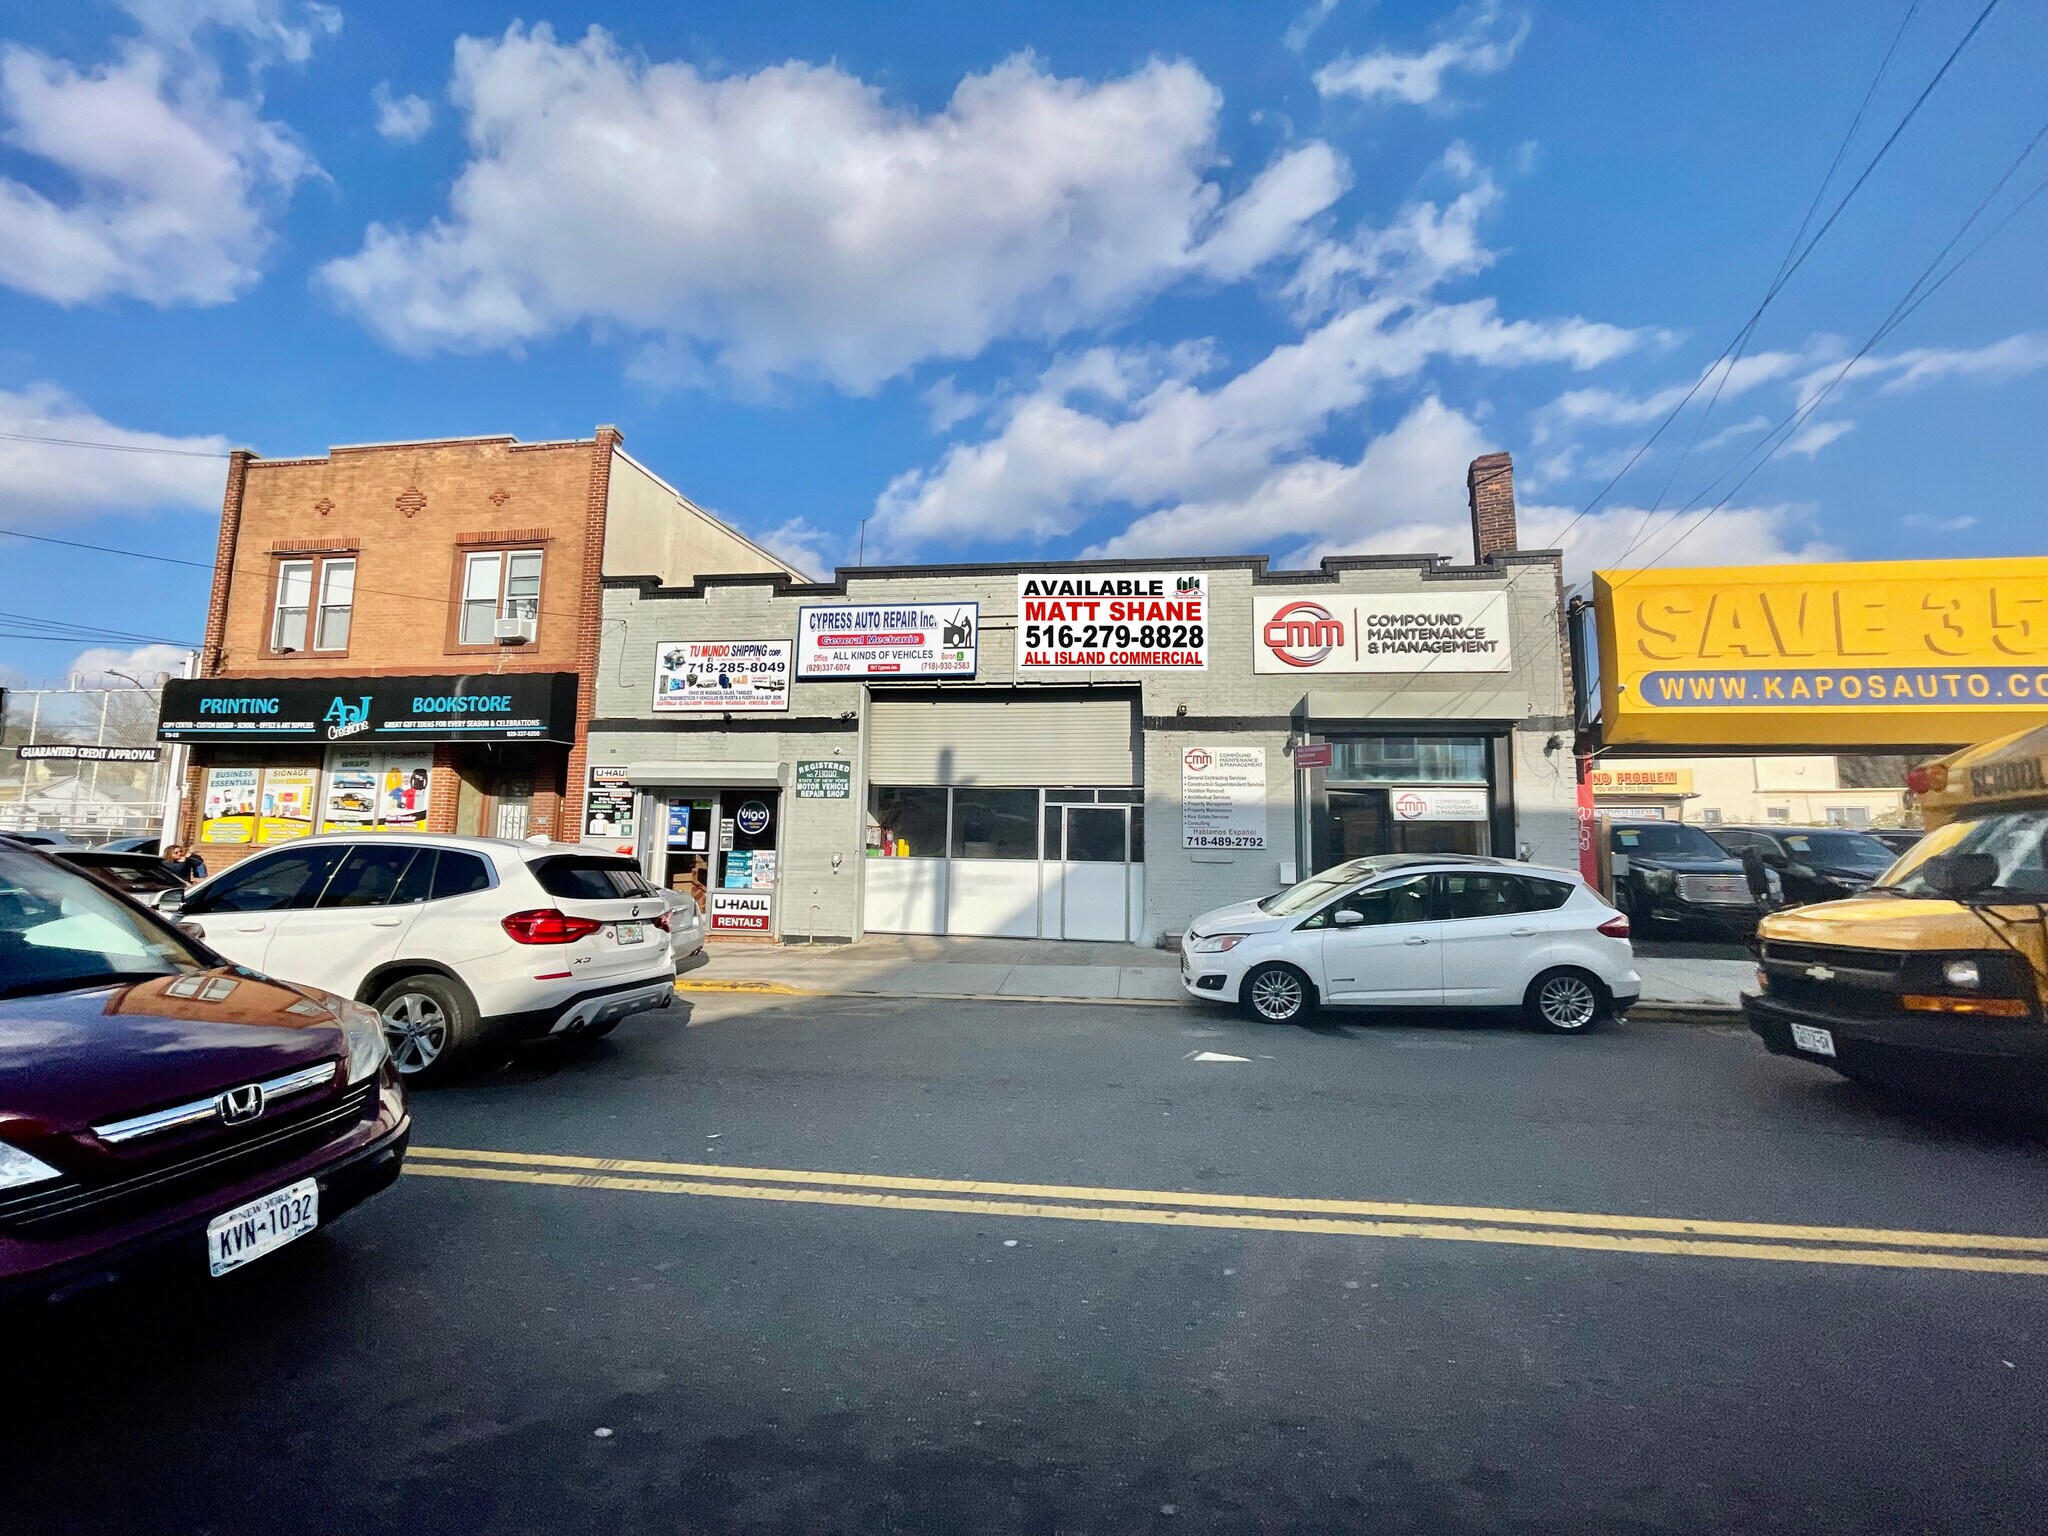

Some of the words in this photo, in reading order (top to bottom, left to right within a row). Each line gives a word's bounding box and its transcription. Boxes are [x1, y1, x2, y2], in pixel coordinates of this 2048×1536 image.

[1024, 580, 1163, 596] AVAILABLE
[1026, 602, 1100, 621] MATT
[1109, 602, 1202, 621] SHANE
[810, 612, 851, 630] CYPRESS
[854, 612, 880, 629] AUTO
[884, 611, 917, 628] REPAIR
[920, 610, 937, 627] Inc.
[1367, 613, 1463, 627] COMPOUND
[1637, 589, 1890, 660] SAVE
[822, 635, 864, 645] General
[867, 634, 919, 644] Mechanic
[1026, 625, 1204, 648] 516-279-8828
[1368, 627, 1486, 640] MAINTENANCE
[690, 645, 700, 657] TU
[701, 645, 730, 657] MUNDO
[730, 644, 768, 657] SHIPPING
[1368, 641, 1379, 654] &
[1382, 640, 1499, 653] MANAGEMENT
[814, 654, 828, 662] Office
[833, 651, 848, 660] ALL
[851, 651, 876, 660] KINDS
[878, 651, 890, 660] OF
[892, 650, 933, 659] VEHICLES
[1024, 652, 1050, 664] ALL
[1055, 652, 1105, 664] ISLAND
[1110, 652, 1202, 664] COMMERCIAL
[688, 662, 785, 673] 718-285-8049
[200, 698, 279, 714] PRINTING
[412, 696, 512, 713] BOOKSTORE
[496, 719, 540, 727] CELEBRATIONS
[328, 721, 369, 740] Creations
[78, 748, 107, 759] CREDIT
[108, 749, 156, 760] APPROVAL
[216, 770, 253, 778] BUSINESS
[273, 769, 309, 777] SIGNAGE
[798, 762, 850, 774] REGISTERED
[210, 779, 257, 787] ESSENTIALS
[1594, 773, 1612, 785] NO
[1618, 772, 1677, 785] PROBLEM
[801, 790, 825, 798] REPAIR
[826, 790, 845, 798] SHOP
[742, 808, 766, 821] vigo
[1187, 837, 1263, 847] 718-489-2792
[714, 899, 768, 911] U-HAUL
[718, 917, 762, 927] RENTALS
